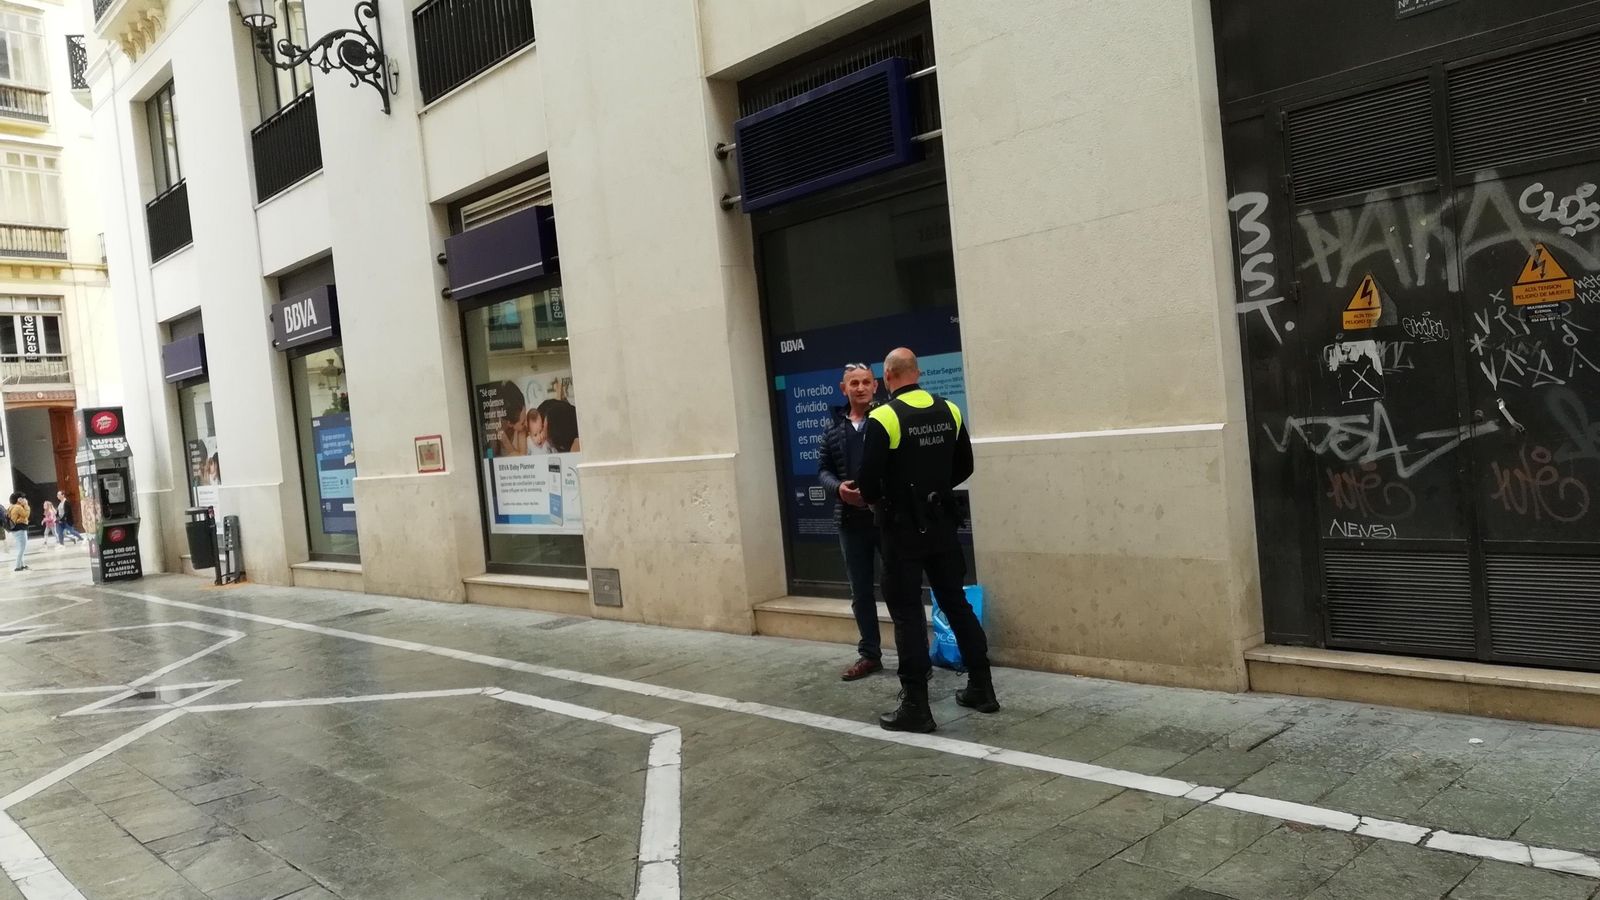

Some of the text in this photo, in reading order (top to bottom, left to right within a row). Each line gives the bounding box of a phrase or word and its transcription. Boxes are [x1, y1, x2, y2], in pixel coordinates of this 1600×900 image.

[283, 298, 318, 334] BBVA
[23, 314, 38, 359] Bershka
[780, 338, 805, 353] BBVA
[927, 367, 962, 376] EstarSeguro
[488, 389, 497, 398] que
[793, 384, 834, 398] Un recibo
[483, 397, 505, 409] podemos
[795, 401, 828, 414] dividido
[484, 408, 507, 419] tener más
[485, 420, 502, 431] tiempo
[797, 417, 819, 429] entre
[908, 422, 953, 436] POLICÍA LOCAL
[486, 433, 497, 442] para
[798, 435, 808, 445] es
[919, 435, 945, 447] MÁLAGA
[510, 463, 520, 471] Baby
[108, 564, 135, 573] ALAMEDA
